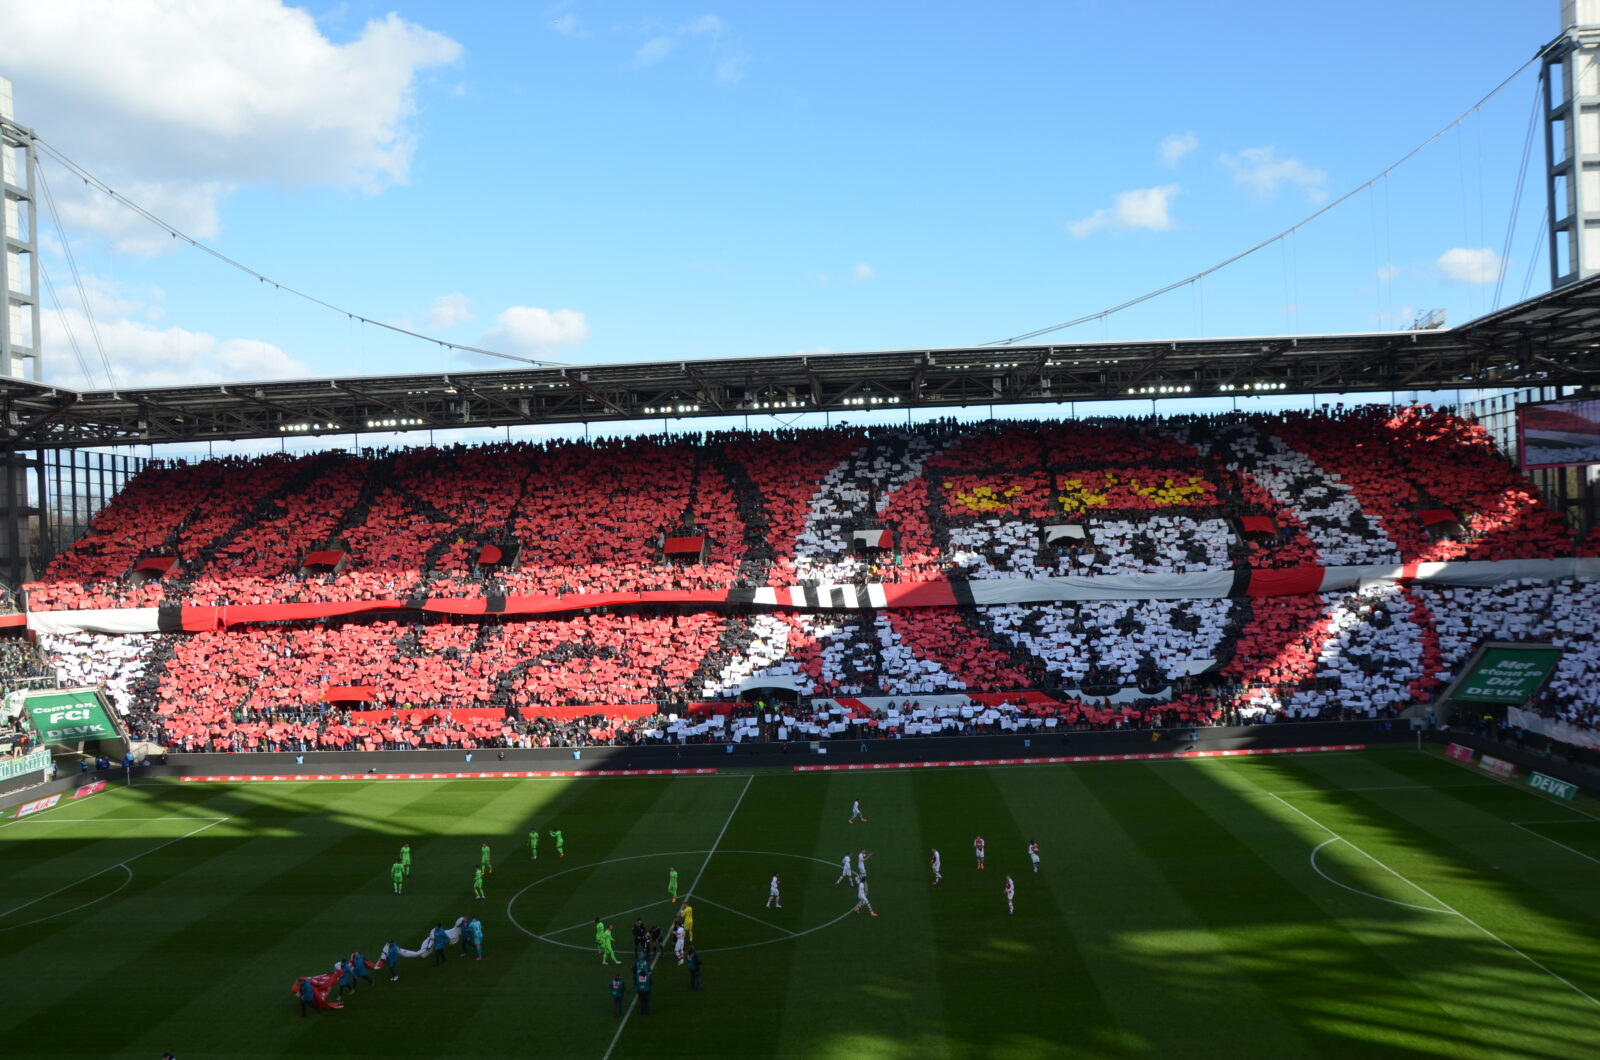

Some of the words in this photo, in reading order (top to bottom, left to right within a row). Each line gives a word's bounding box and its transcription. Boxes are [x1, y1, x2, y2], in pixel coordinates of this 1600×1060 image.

[1466, 687, 1524, 696] DEVK
[33, 704, 73, 714] Come
[50, 709, 90, 724] FC!
[47, 724, 104, 737] DEVK
[1530, 775, 1569, 798] DEVK
